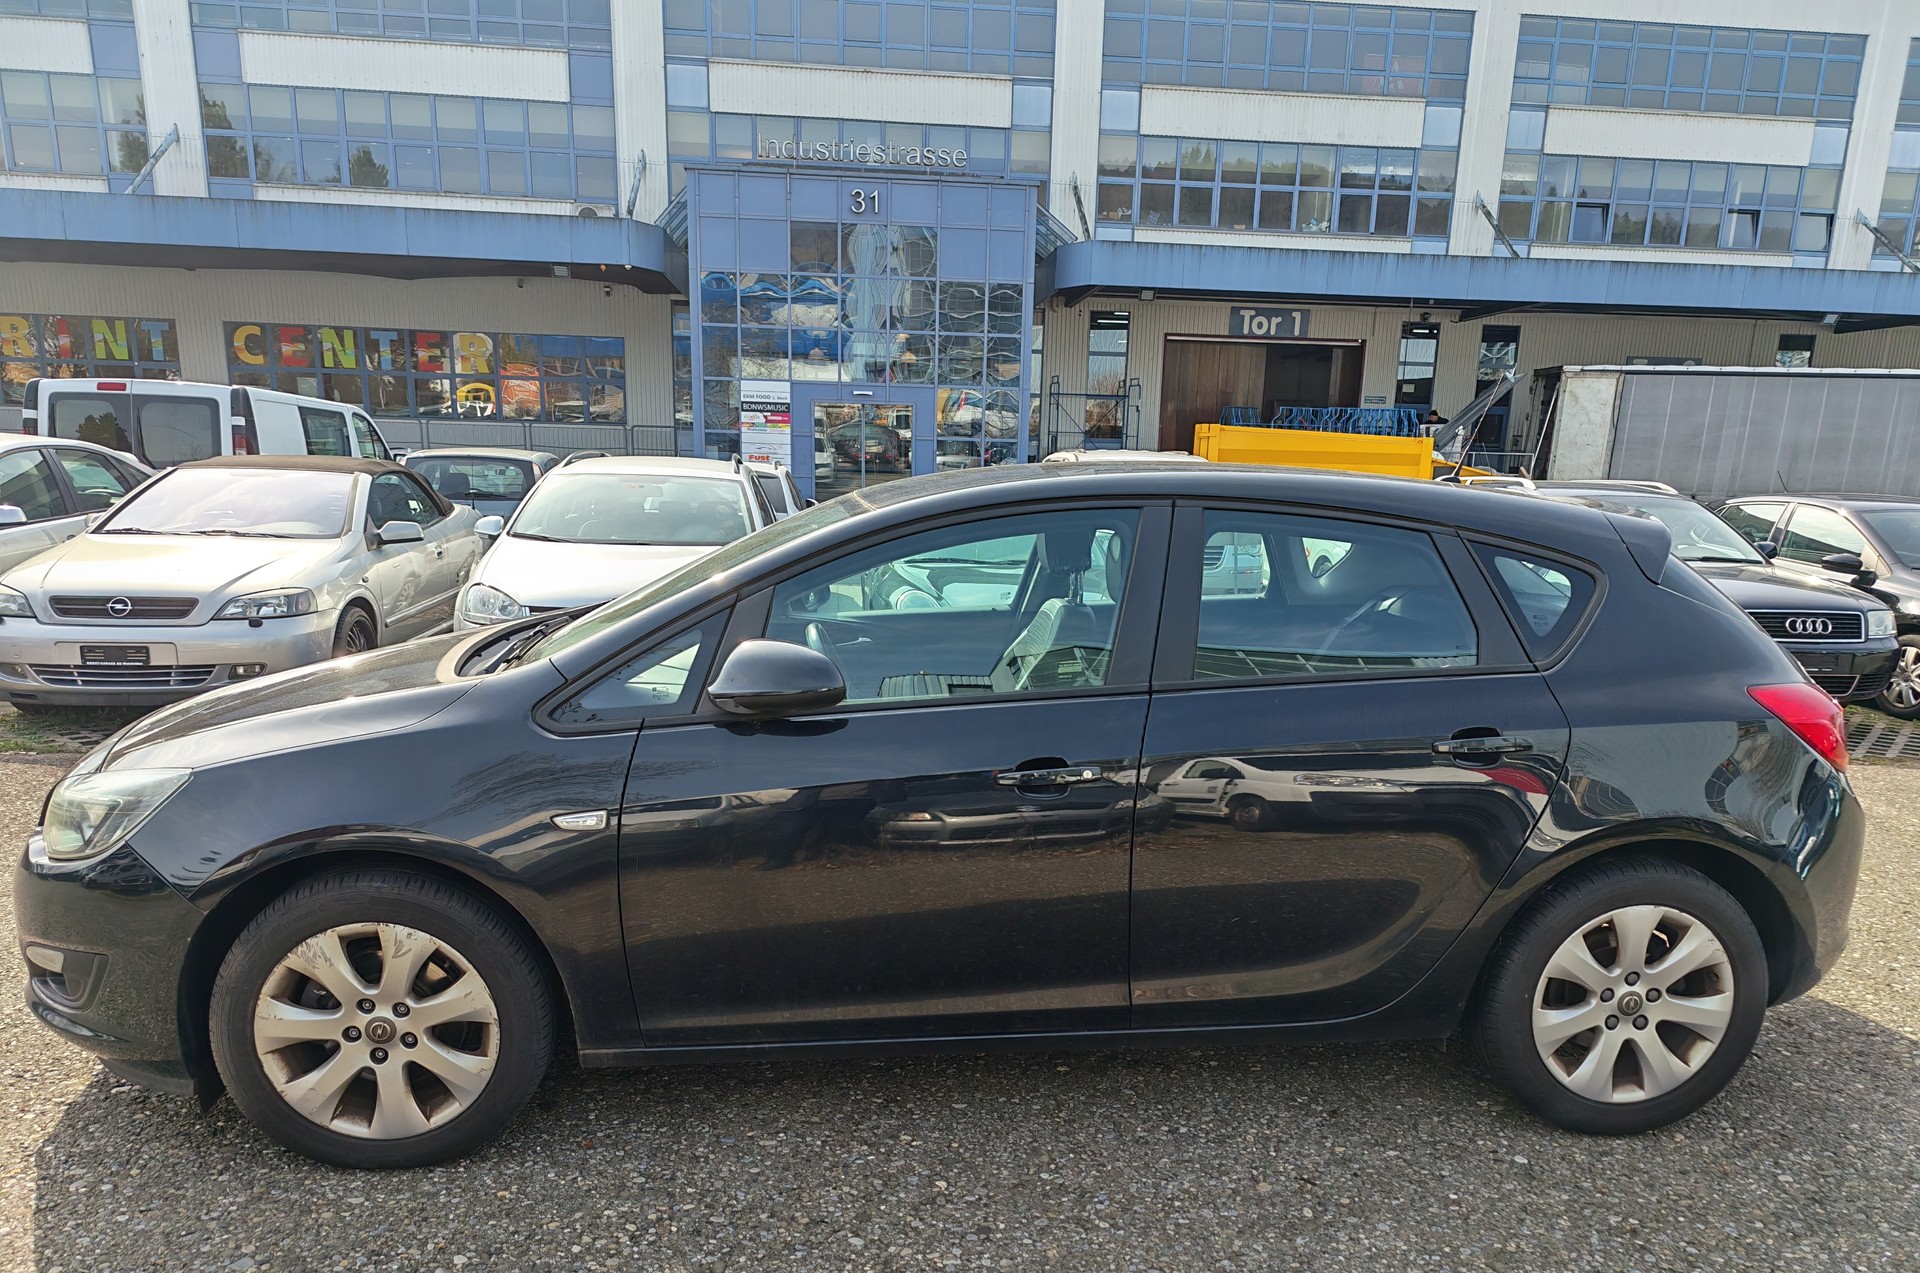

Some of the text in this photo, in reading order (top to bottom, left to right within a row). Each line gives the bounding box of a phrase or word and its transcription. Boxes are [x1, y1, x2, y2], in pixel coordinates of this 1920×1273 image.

[757, 132, 967, 167] Industriestrasse
[851, 189, 879, 214] 31
[1240, 310, 1301, 336] Tor 1
[0, 315, 491, 374] RINT CENTER
